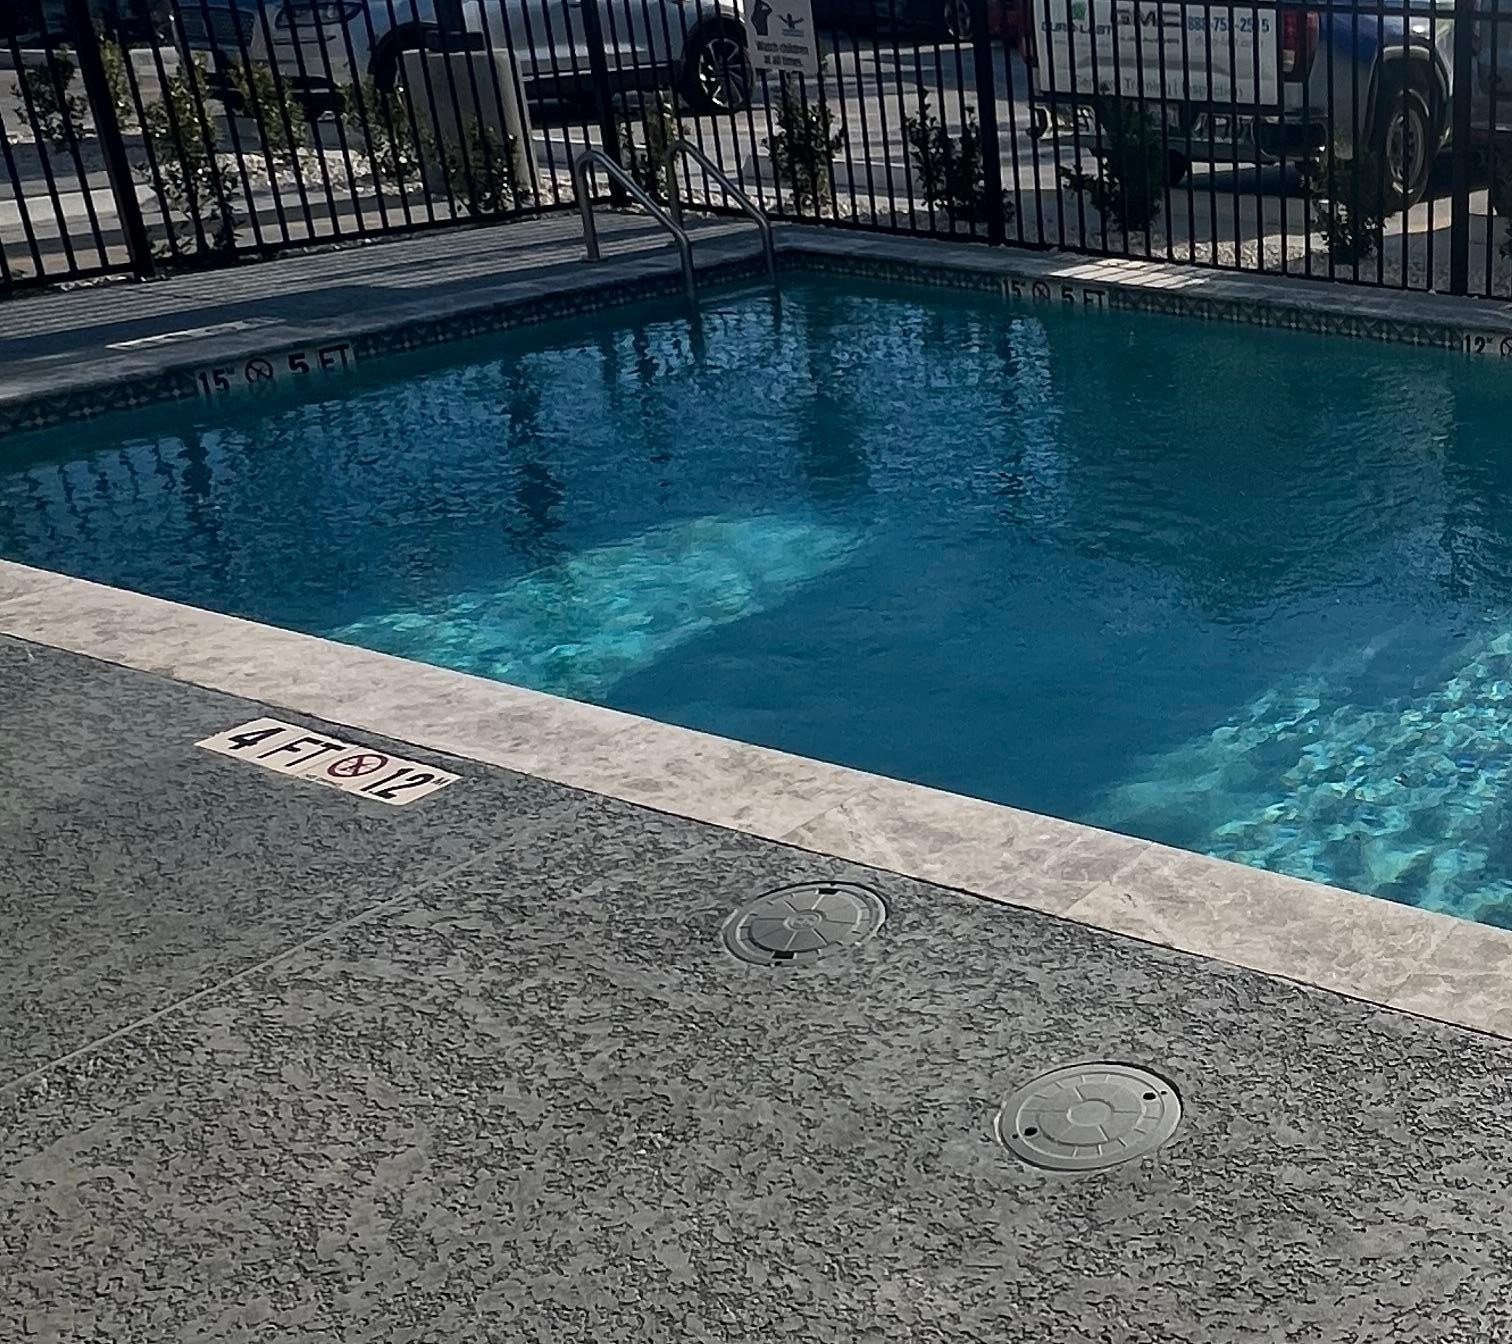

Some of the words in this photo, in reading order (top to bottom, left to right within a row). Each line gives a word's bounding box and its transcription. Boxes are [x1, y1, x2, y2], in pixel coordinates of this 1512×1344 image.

[288, 353, 310, 375] 5
[317, 344, 350, 372] FT
[227, 727, 287, 751] 4
[256, 736, 348, 768] FT
